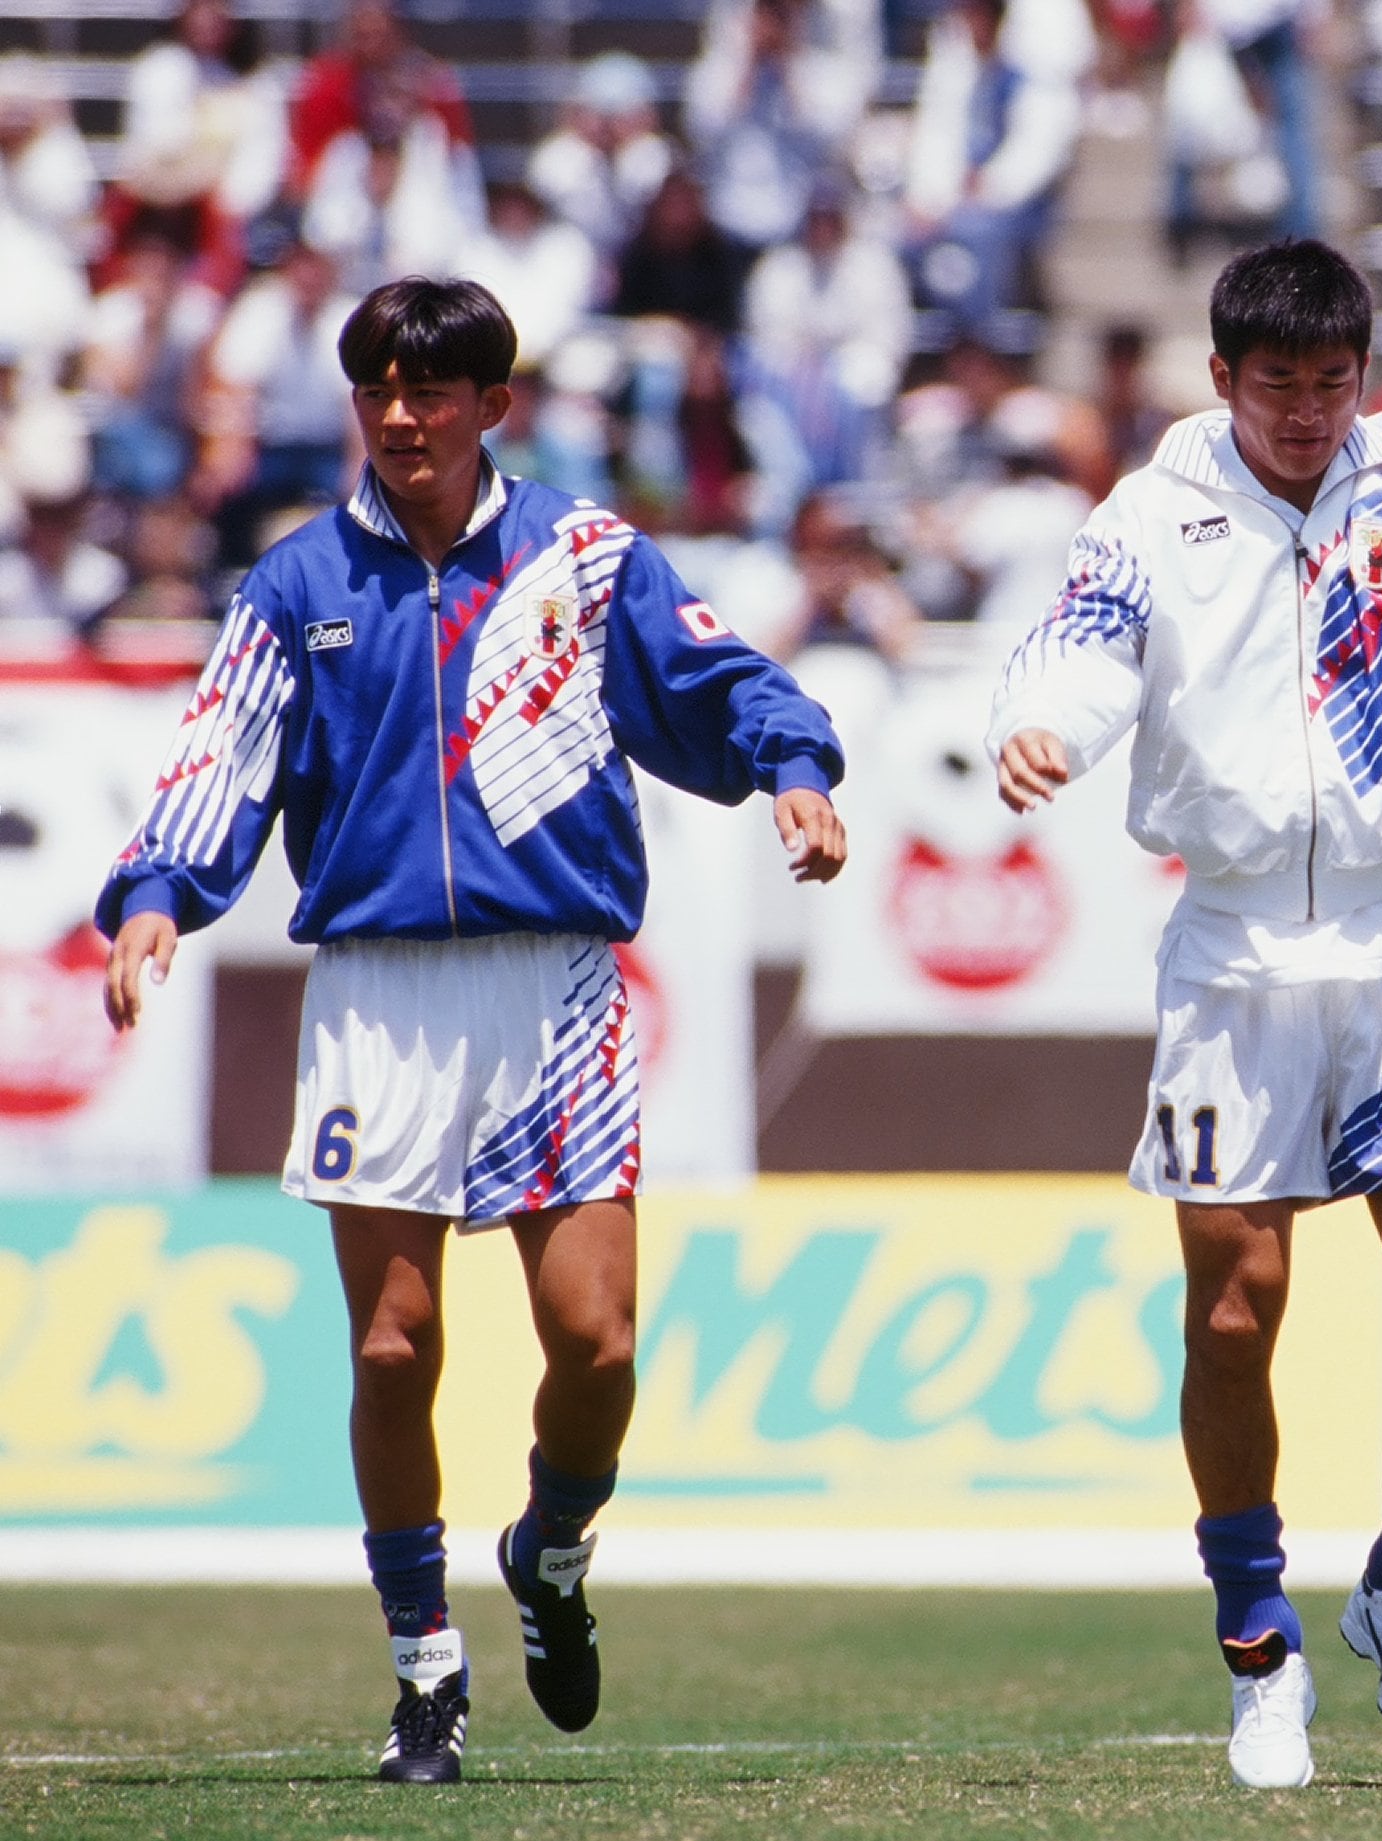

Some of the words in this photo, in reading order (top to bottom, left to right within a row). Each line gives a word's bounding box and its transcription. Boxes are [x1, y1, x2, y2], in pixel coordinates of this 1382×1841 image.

[312, 1106, 360, 1182] 6
[1157, 1105, 1219, 1187] 11
[399, 1649, 454, 1665] adidas
